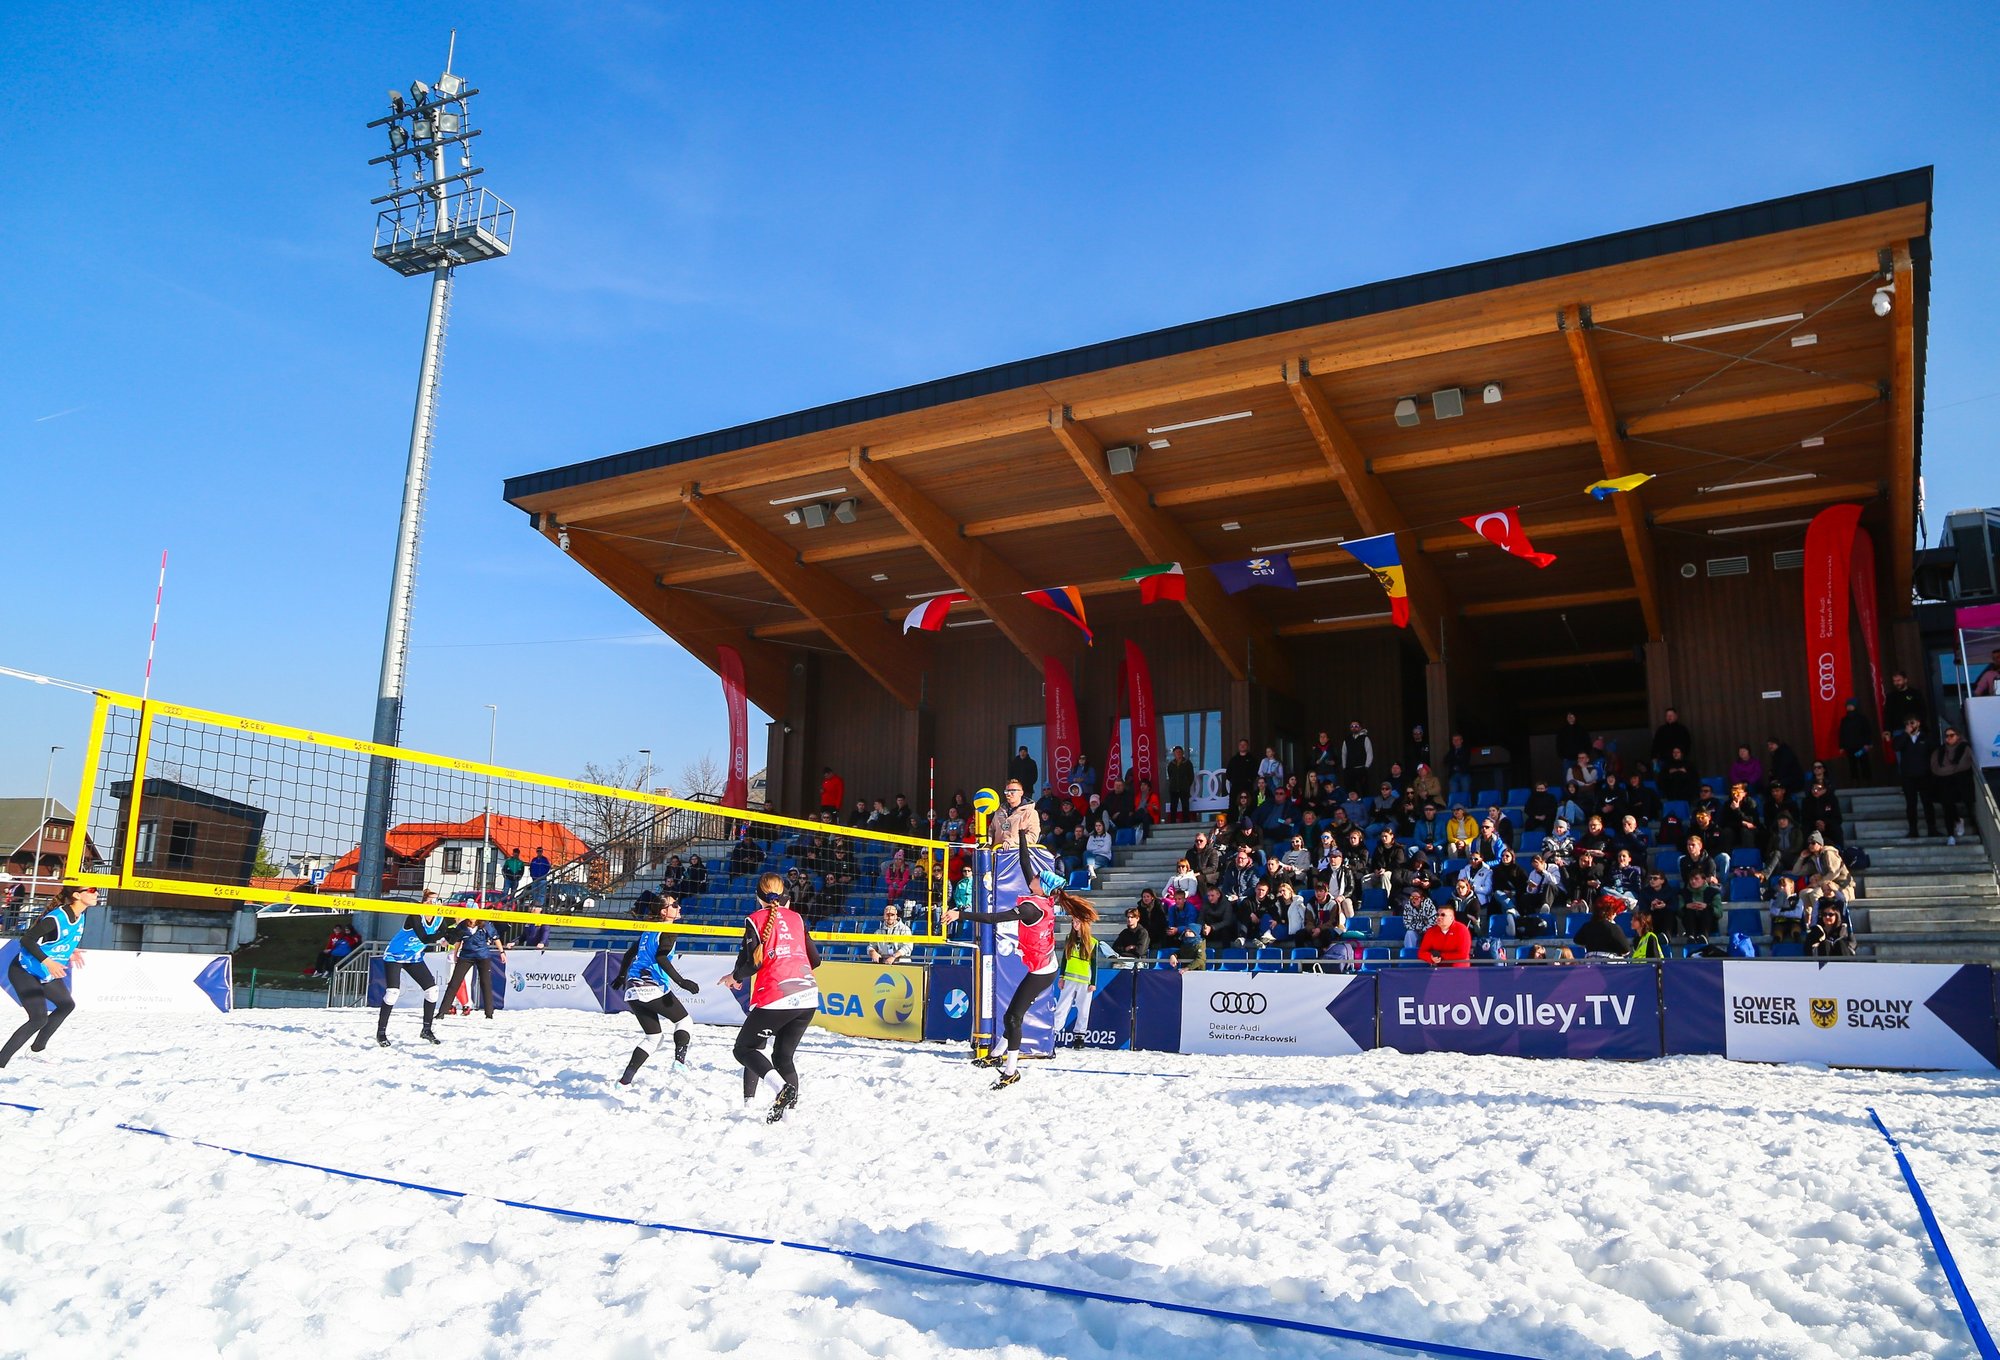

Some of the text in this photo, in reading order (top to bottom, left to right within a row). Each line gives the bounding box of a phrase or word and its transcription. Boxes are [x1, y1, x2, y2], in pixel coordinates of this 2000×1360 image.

[1252, 568, 1275, 576] CEV
[250, 723, 266, 731] CEV
[362, 744, 376, 752] CEV
[461, 762, 474, 770] CEV
[342, 899, 356, 907] CEV
[444, 908, 457, 916] CEV
[778, 920, 789, 932] 3
[779, 932, 794, 941] POL
[525, 972, 577, 982] SNOW VOLLEY
[541, 983, 570, 991] POLAND
[816, 991, 865, 1018] ASA
[1733, 996, 1913, 1014] LOWER DOLNY
[1398, 994, 1636, 1033] EuroVolley.TV
[1733, 1010, 1911, 1031] SILESIA ŚLĄSK
[1209, 1022, 1261, 1032] Dealer Audi
[1084, 1030, 1117, 1045] 2025
[1208, 1031, 1297, 1043] Świtoń-Paczkowski
